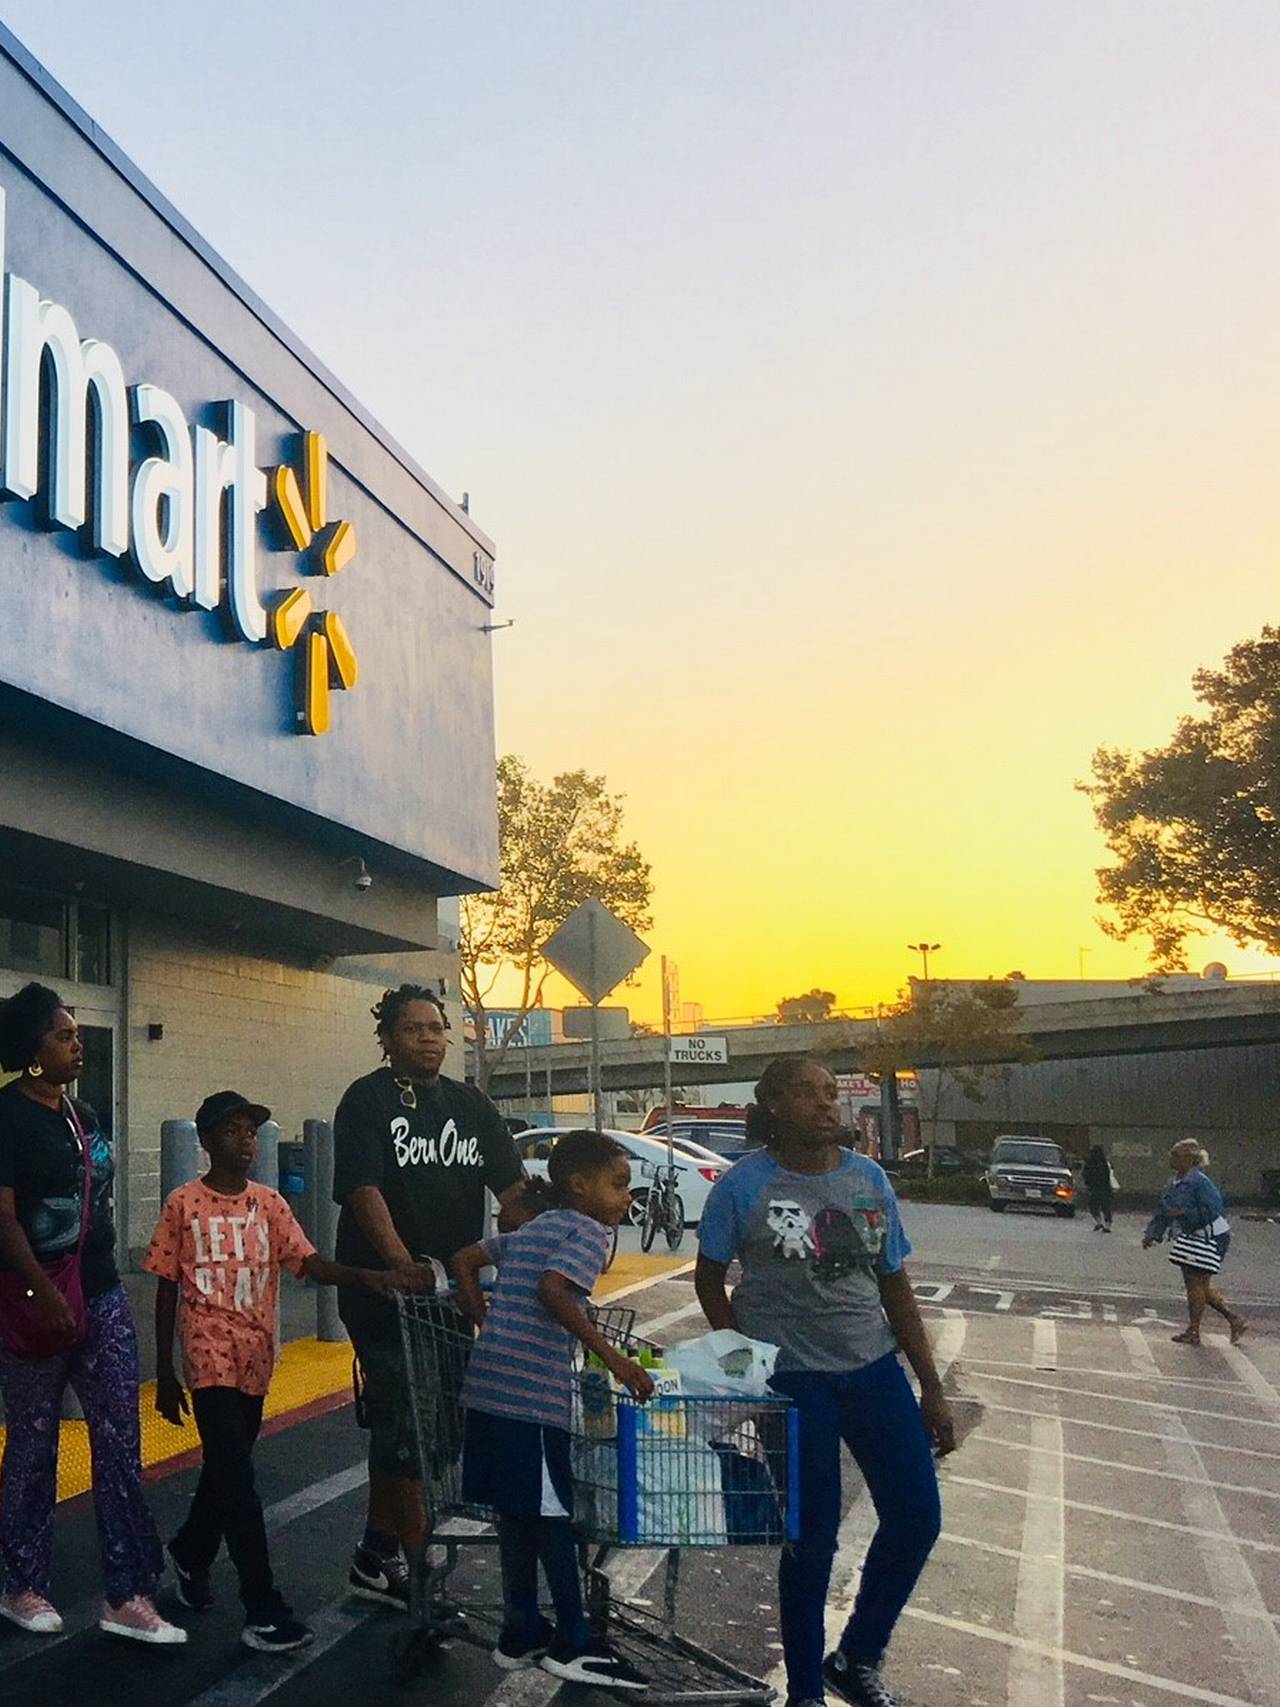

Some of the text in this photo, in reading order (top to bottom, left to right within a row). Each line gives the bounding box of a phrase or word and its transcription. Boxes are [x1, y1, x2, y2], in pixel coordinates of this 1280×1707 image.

[688, 1039, 706, 1049] NO
[674, 1050, 722, 1061] TRUCKS
[439, 1117, 479, 1167] One
[191, 1204, 270, 1263] LET'S
[656, 1379, 678, 1397] OON
